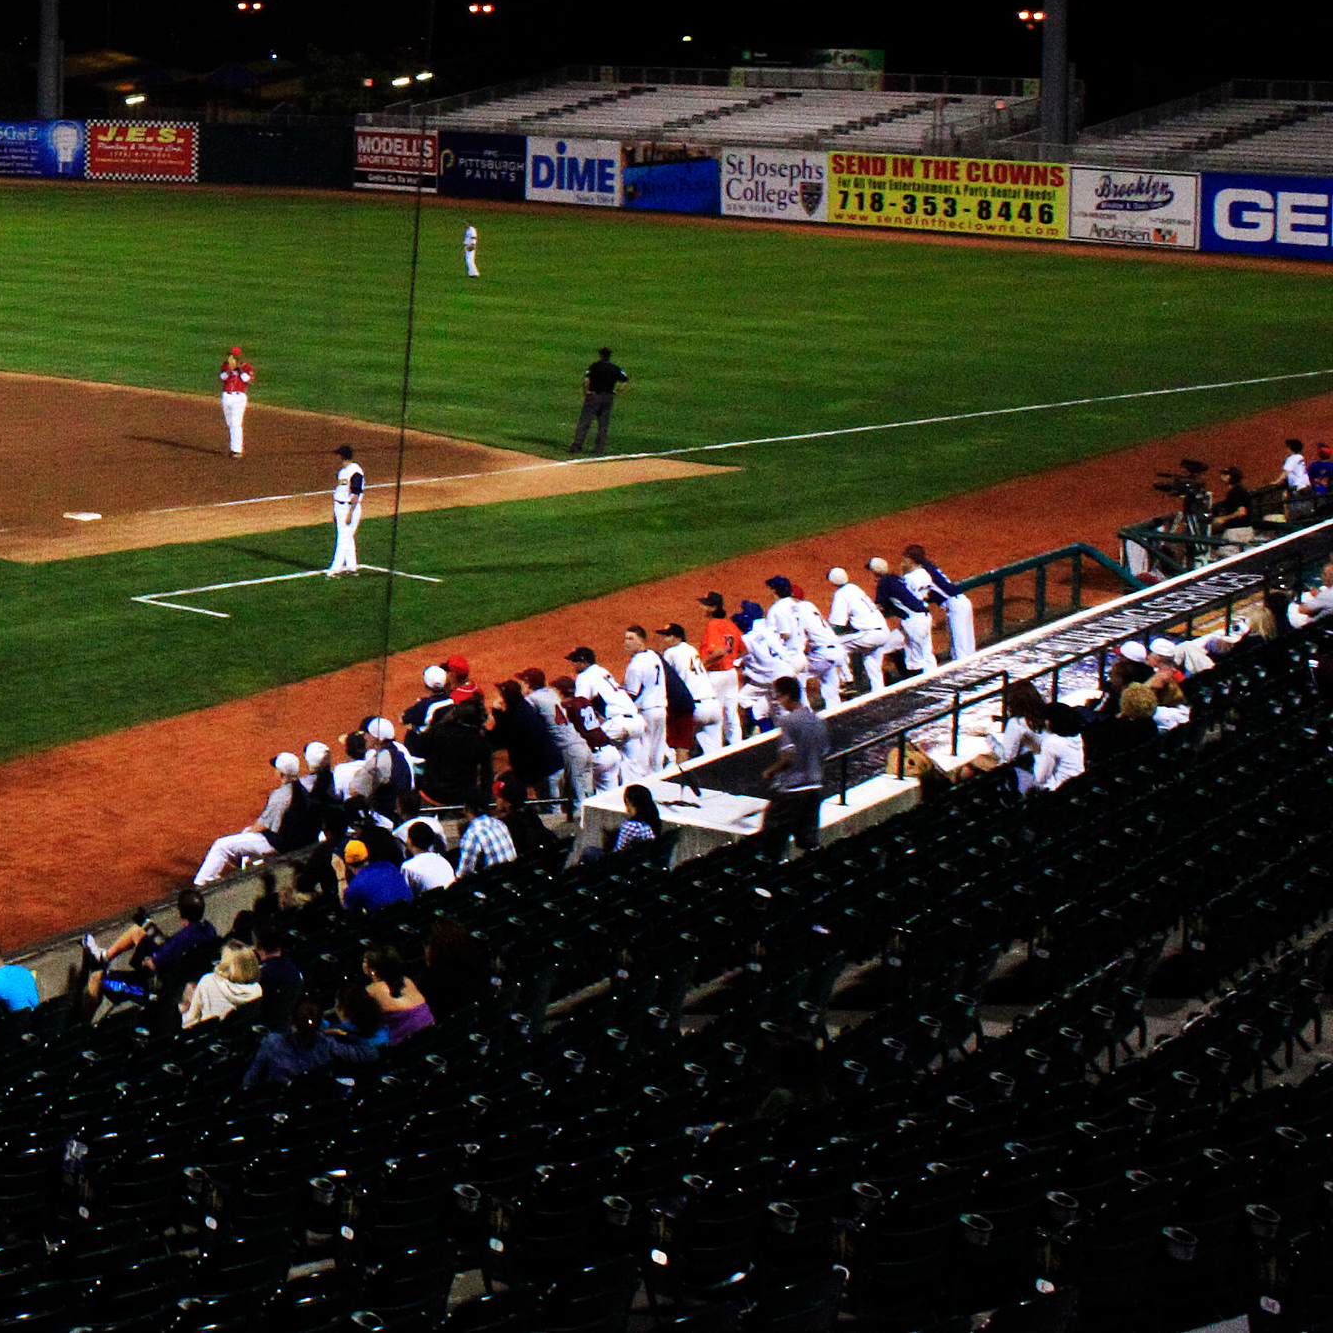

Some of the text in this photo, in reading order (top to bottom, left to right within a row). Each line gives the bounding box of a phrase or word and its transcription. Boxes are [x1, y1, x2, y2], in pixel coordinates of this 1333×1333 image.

[97, 126, 185, 144] J.E.S.
[357, 136, 433, 158] MODELL'S
[357, 156, 433, 169] SPORTING GOODS
[458, 157, 525, 172] PITTSBURGH
[832, 154, 1064, 187] SEND IN THE CLOWNS
[465, 168, 517, 182] PAINTS
[1095, 174, 1170, 198] Brooklyn
[725, 178, 799, 213] College
[838, 177, 851, 187] For
[853, 177, 865, 188] All
[868, 178, 887, 190] Your
[889, 180, 953, 194] Entertainment
[963, 184, 988, 197] Party
[991, 186, 1021, 199] Rental
[838, 191, 1054, 224] 718-353-8446
[1213, 187, 1333, 247] GE
[834, 213, 1059, 235] www.sendintheclowns.com
[1090, 223, 1151, 242] Andersen
